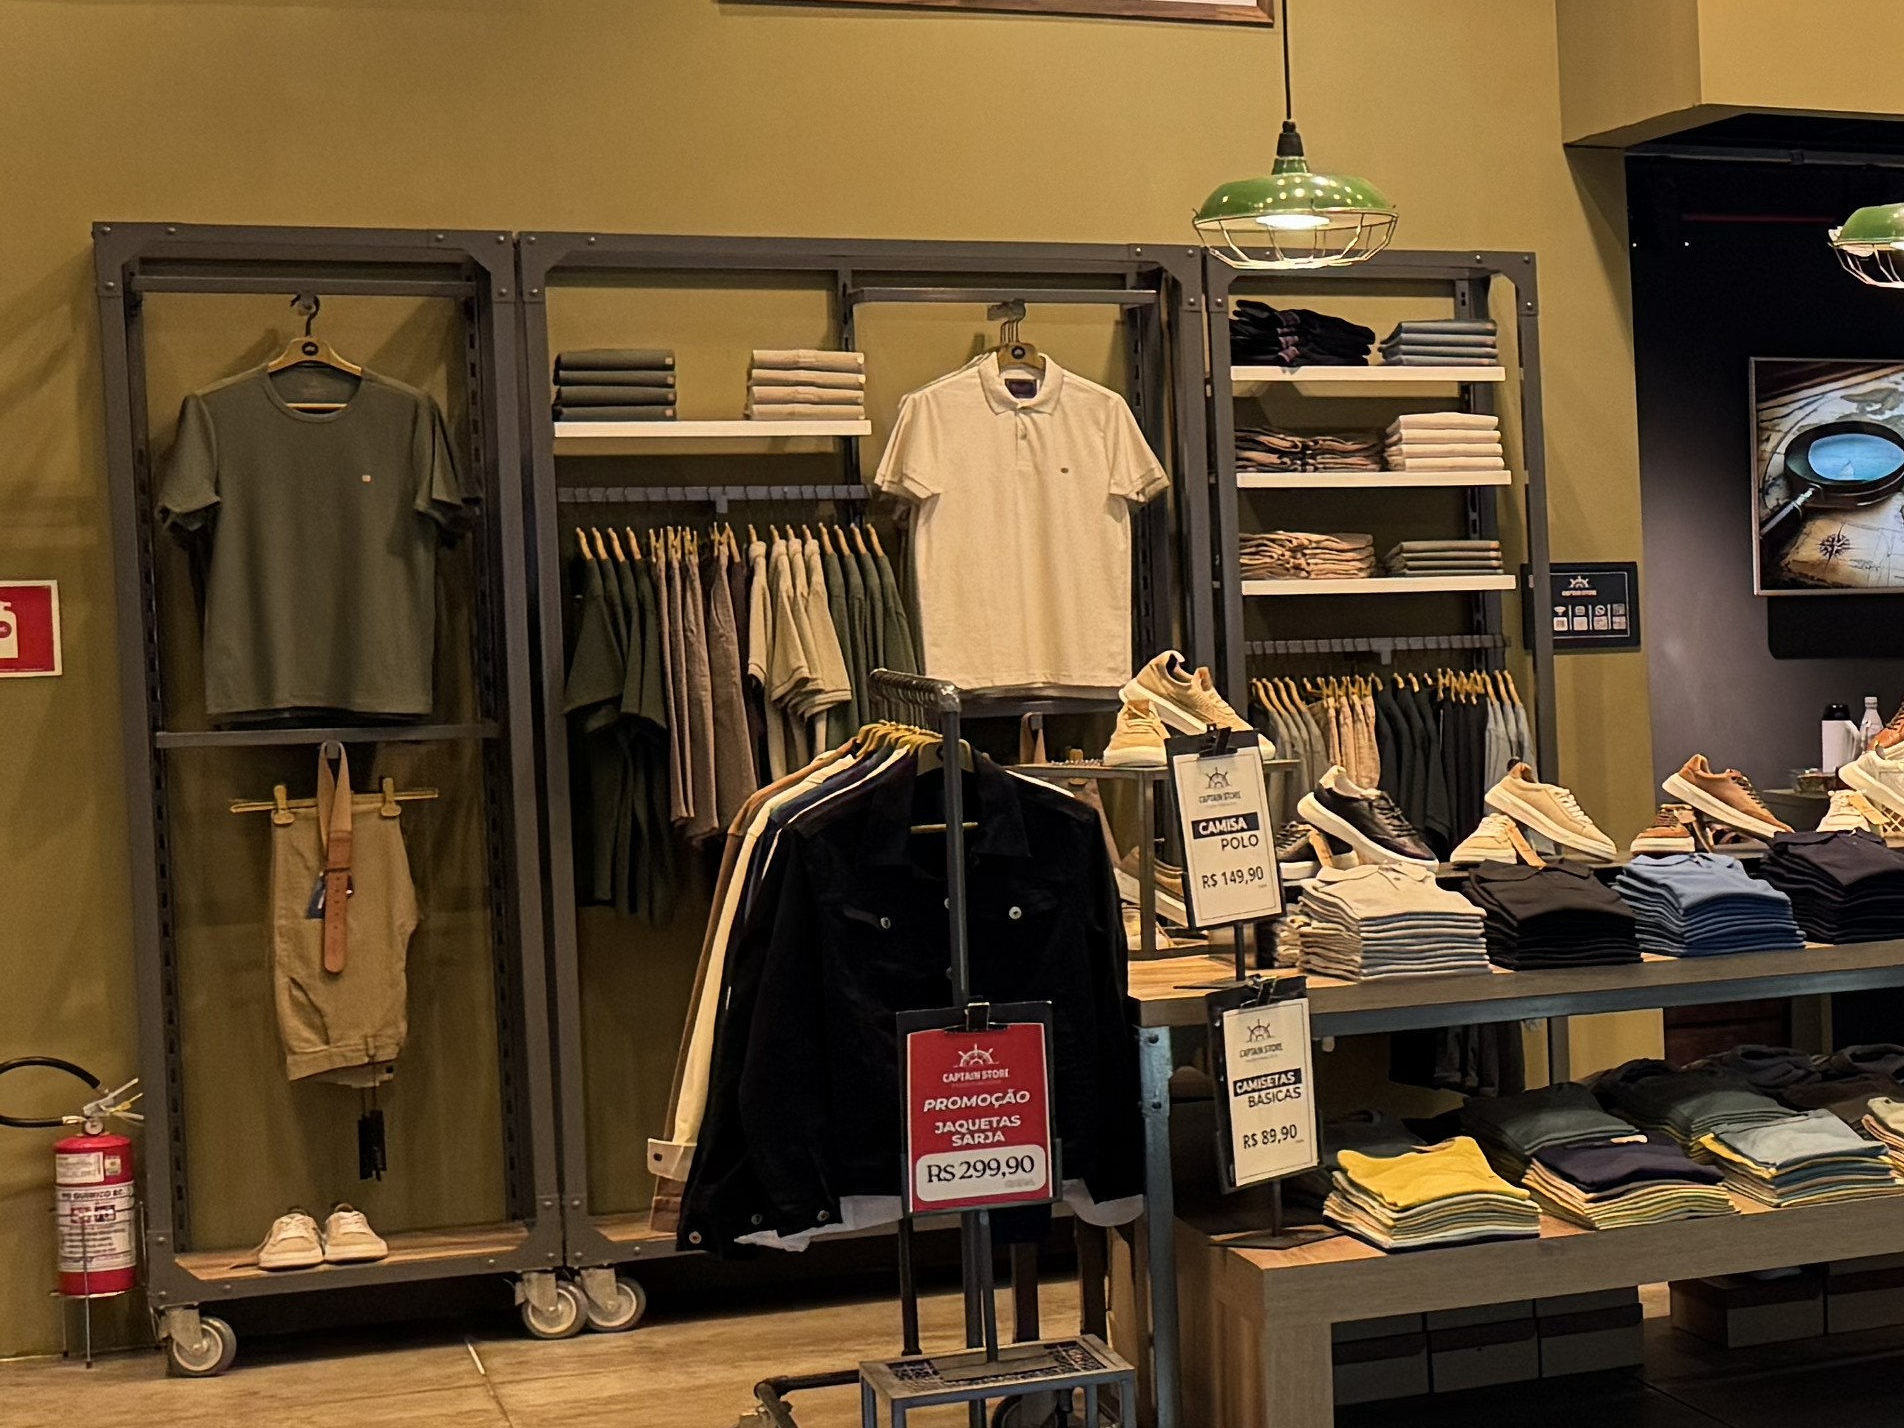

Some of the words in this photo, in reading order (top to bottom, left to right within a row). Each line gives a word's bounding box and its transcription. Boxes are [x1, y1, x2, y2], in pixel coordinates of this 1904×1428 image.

[1199, 819, 1246, 834] CAMISA
[1221, 834, 1259, 851] POLO
[1202, 873, 1218, 888] R$
[1221, 866, 1264, 886] 149,90
[943, 1071, 980, 1082] CAPTAIN
[1236, 1073, 1295, 1095] CAMISETAS
[924, 1089, 1030, 1112] PROMOÇÃO
[935, 1115, 1021, 1134] JAQUETAS
[952, 1133, 1005, 1147] SARJA
[1243, 1133, 1258, 1149] R$
[1261, 1124, 1298, 1146] 89,90
[959, 1155, 1034, 1180] 299,90
